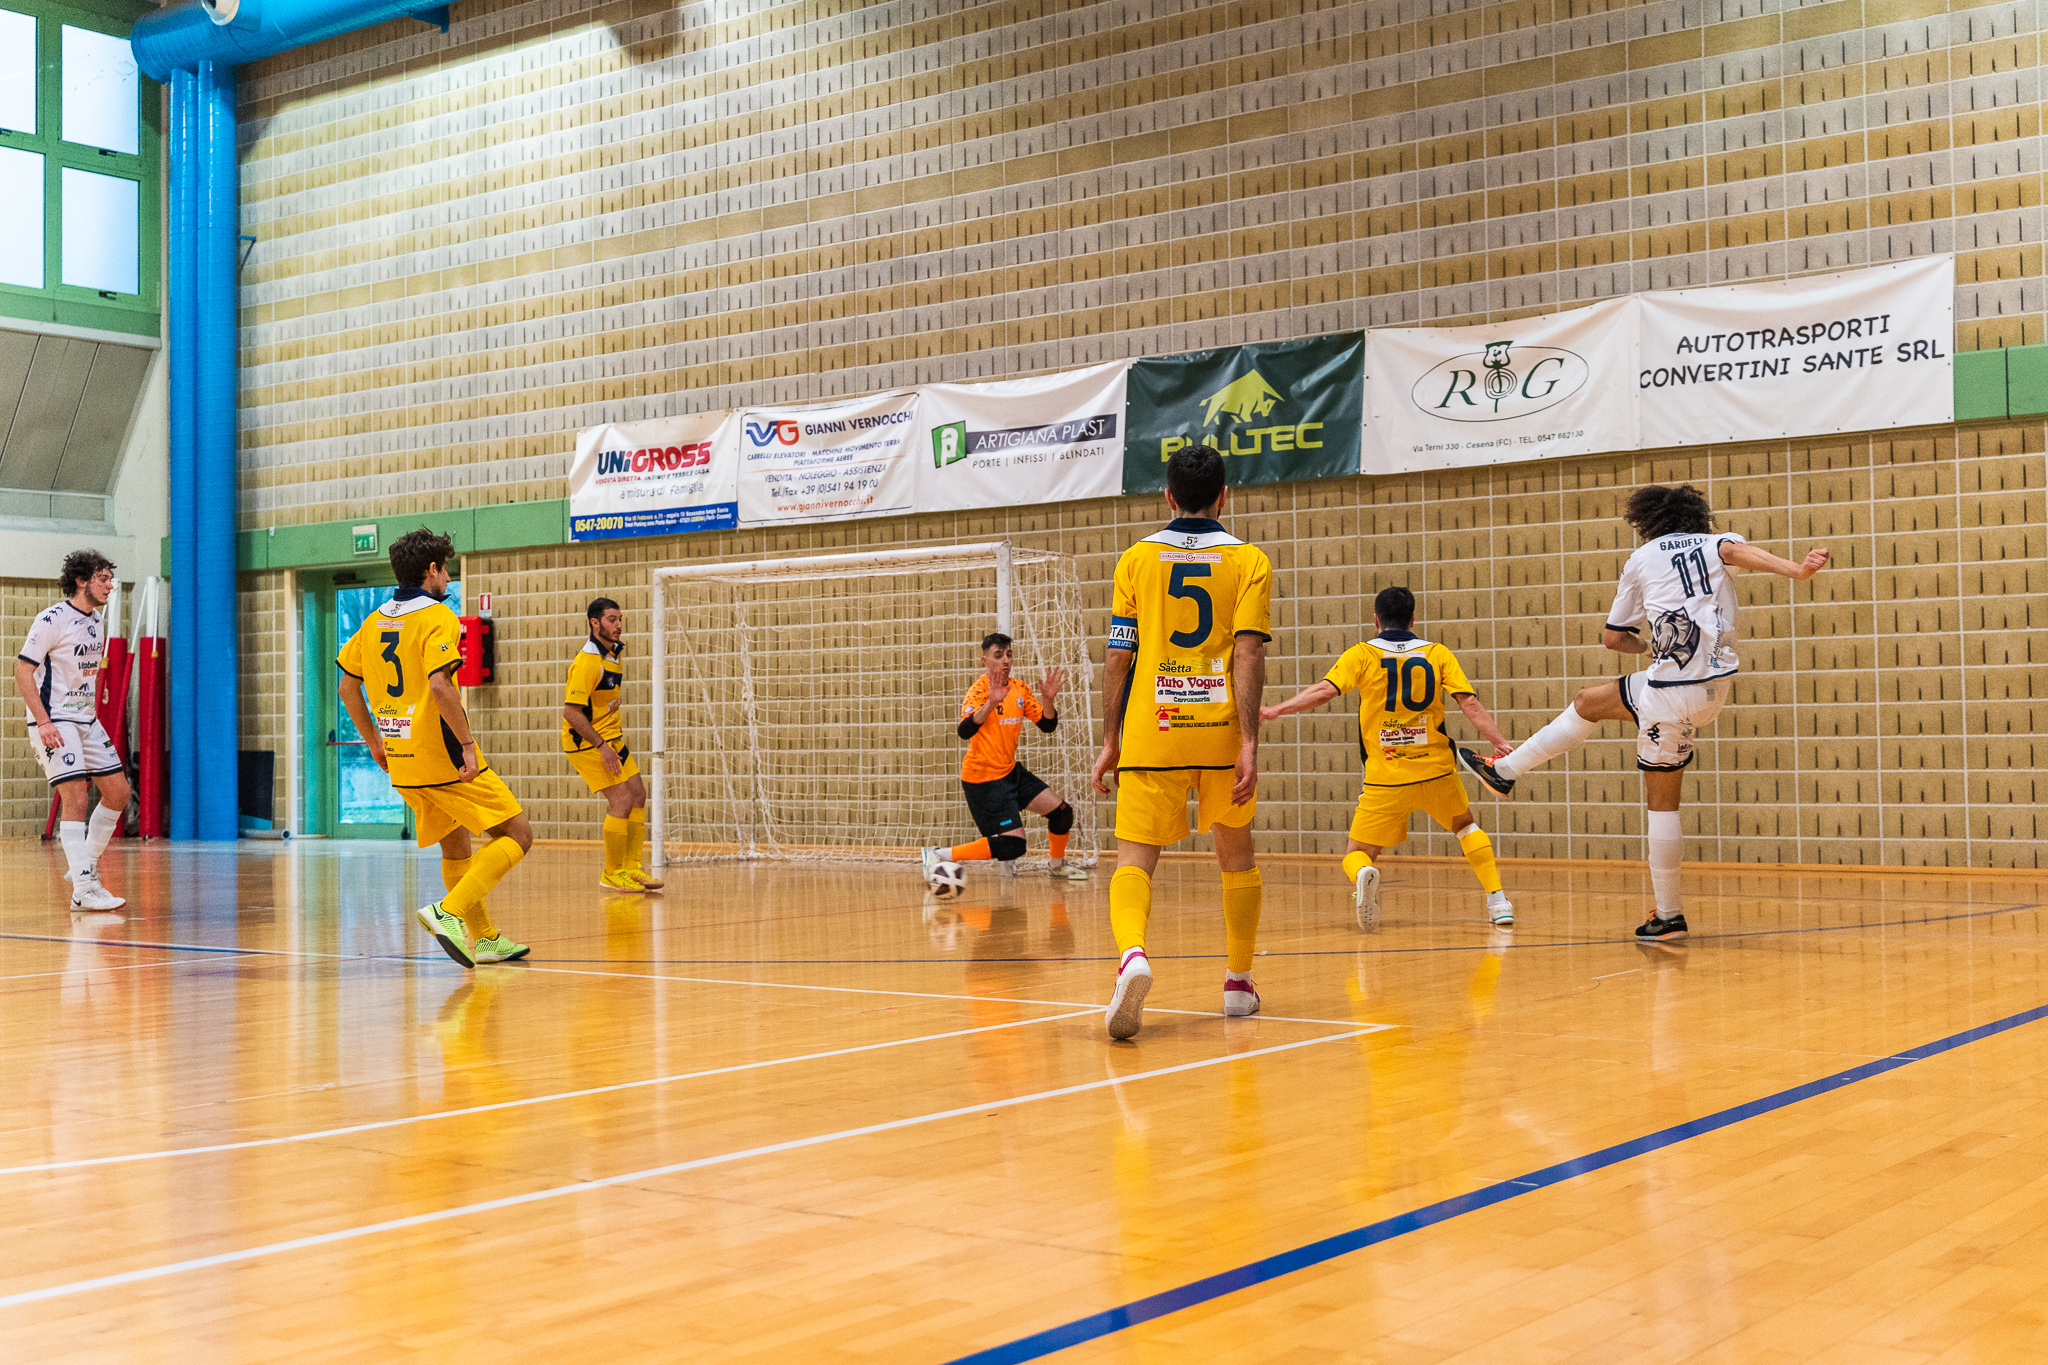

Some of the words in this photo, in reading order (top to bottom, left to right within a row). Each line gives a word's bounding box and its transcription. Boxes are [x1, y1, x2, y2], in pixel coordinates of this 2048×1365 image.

[1676, 314, 1890, 354] AUTOTRASPORTI
[1640, 356, 1791, 388] CONVERTINI
[1802, 346, 1882, 373] SANTE
[1896, 339, 1945, 363] SRL
[1434, 369, 1478, 409] R
[1521, 357, 1564, 399] G
[805, 420, 846, 435] GIANNI
[848, 410, 914, 430] VERNOCCHI
[975, 427, 1058, 450] ARTIGIANA
[1062, 419, 1105, 440] PLAST
[1425, 443, 1443, 451] Terni
[1466, 441, 1494, 449] Cesena
[1496, 438, 1512, 447] (FC)
[1537, 433, 1555, 442] 0547
[773, 451, 806, 459] ELEVATORI
[812, 448, 843, 456] MACCHINE
[845, 442, 882, 452] MOVIMENTO
[972, 460, 1000, 469] PORTE
[1013, 456, 1047, 464] INFISSI
[1060, 447, 1104, 460] BLINDATI
[793, 457, 834, 466] PIATTAFORME
[836, 454, 853, 462] AEREE
[764, 473, 792, 482] VENDITA
[798, 471, 837, 481] NOLEGGIO
[843, 464, 887, 476] ASSISTENZA
[627, 487, 655, 498] misura
[801, 486, 816, 495] +39
[844, 482, 854, 491] 94
[858, 480, 867, 490] 19
[777, 496, 874, 512] www.giannivernocchi.it
[574, 516, 624, 532] 0547-20070
[1660, 538, 1708, 550] GARDELL
[1671, 547, 1714, 598] 11
[1168, 563, 1214, 648] 5
[1110, 626, 1137, 641] TAIN
[380, 631, 404, 698] 3
[1158, 662, 1192, 673] Saetta
[1156, 676, 1184, 688] Auto
[1187, 677, 1224, 690] Vogue
[1380, 657, 1436, 712] 10
[392, 718, 411, 728] Vogue
[1401, 728, 1426, 736] Vogue
